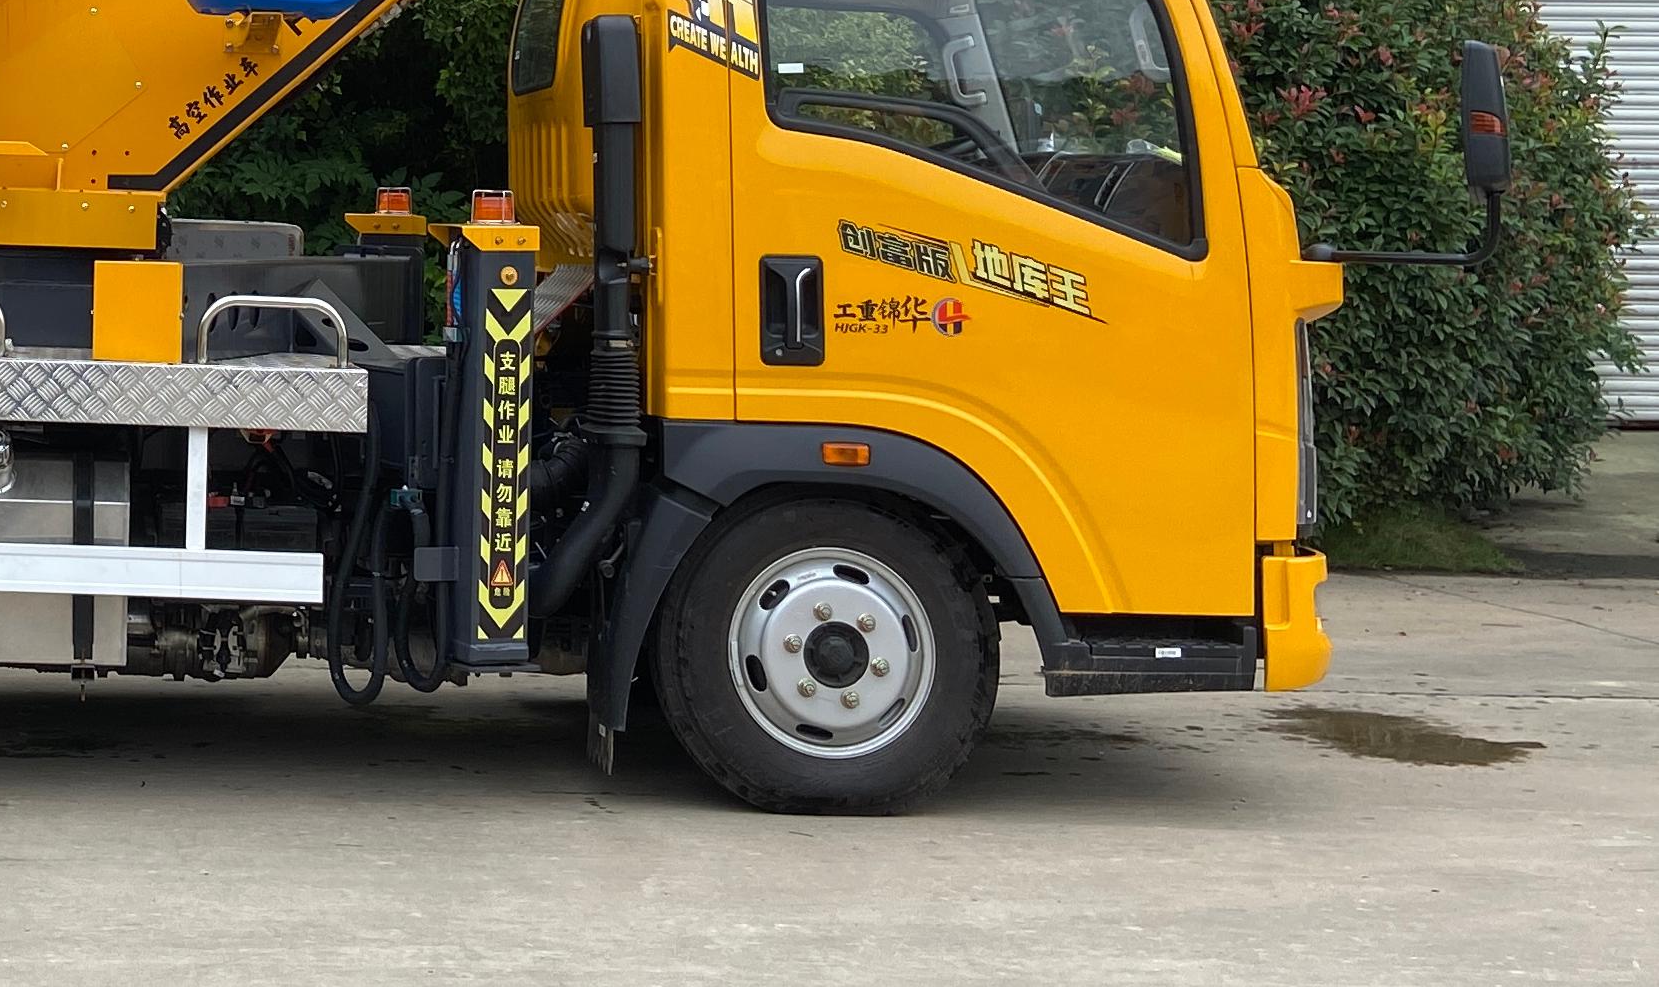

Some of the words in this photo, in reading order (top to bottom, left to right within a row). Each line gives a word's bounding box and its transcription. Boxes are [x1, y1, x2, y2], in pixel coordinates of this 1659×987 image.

[670, 15, 708, 50] CREATE
[168, 57, 259, 140] 高空作业车
[838, 219, 957, 283] 创富版
[972, 239, 1092, 317] 地库王
[834, 322, 888, 334] HJGK-33
[497, 351, 516, 444] 支腿作业
[495, 459, 513, 552] 请勿靠近
